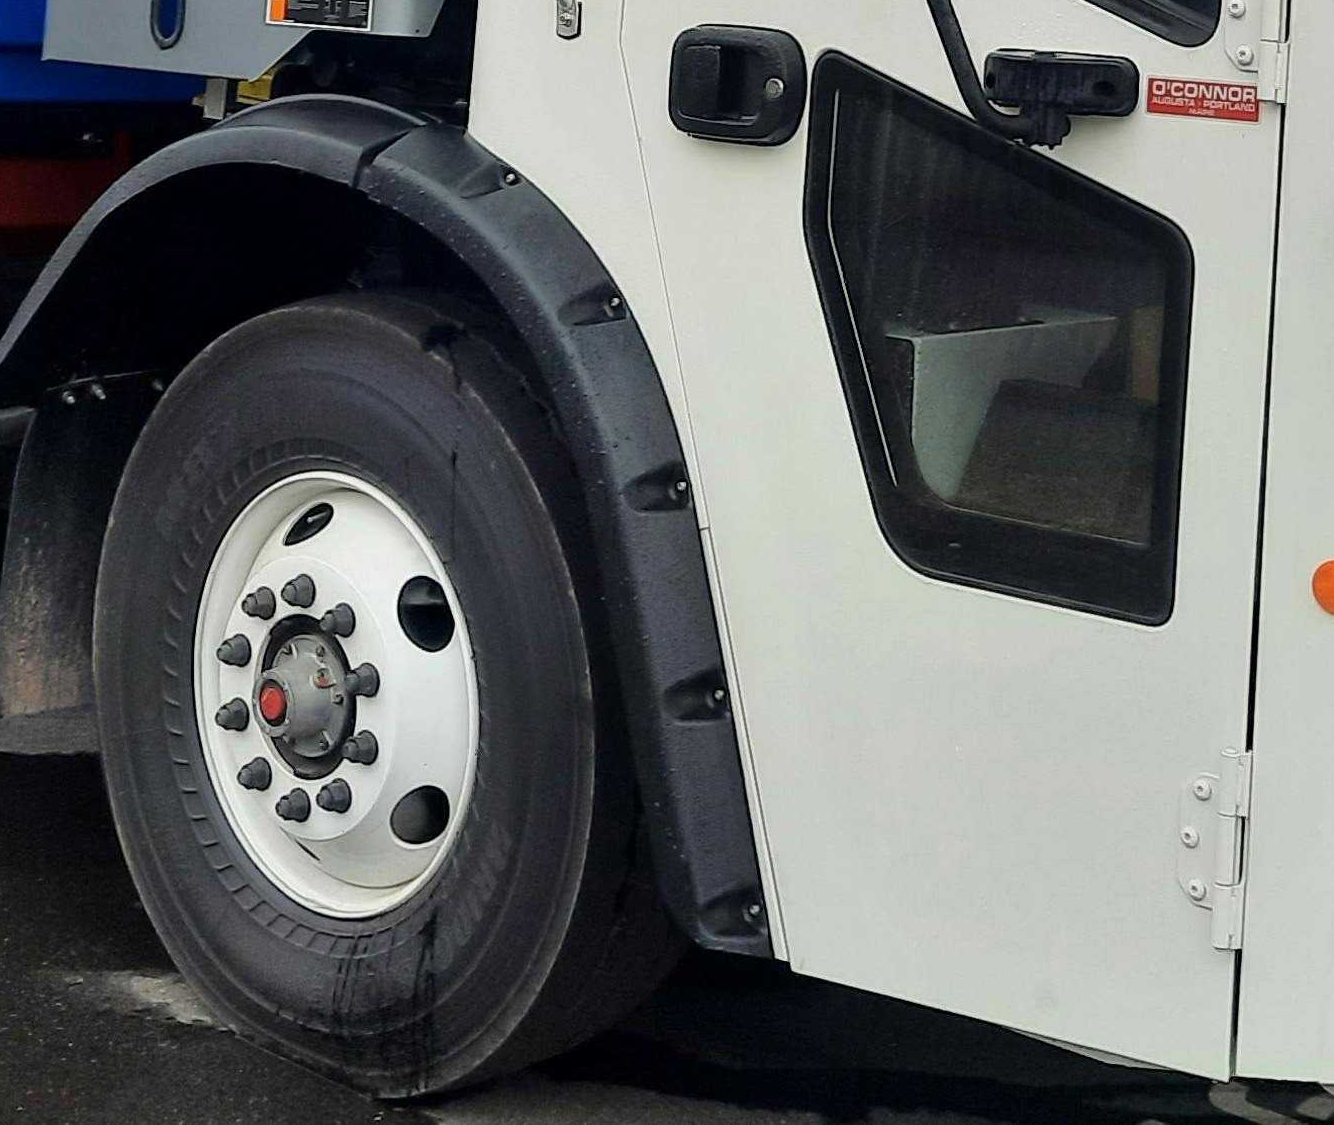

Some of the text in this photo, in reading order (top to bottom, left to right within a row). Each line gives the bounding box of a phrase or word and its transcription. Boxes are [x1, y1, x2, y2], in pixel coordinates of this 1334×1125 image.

[1152, 80, 1256, 103] O'CONNOR
[1151, 97, 1256, 112] AUGUSTA PORTLAND
